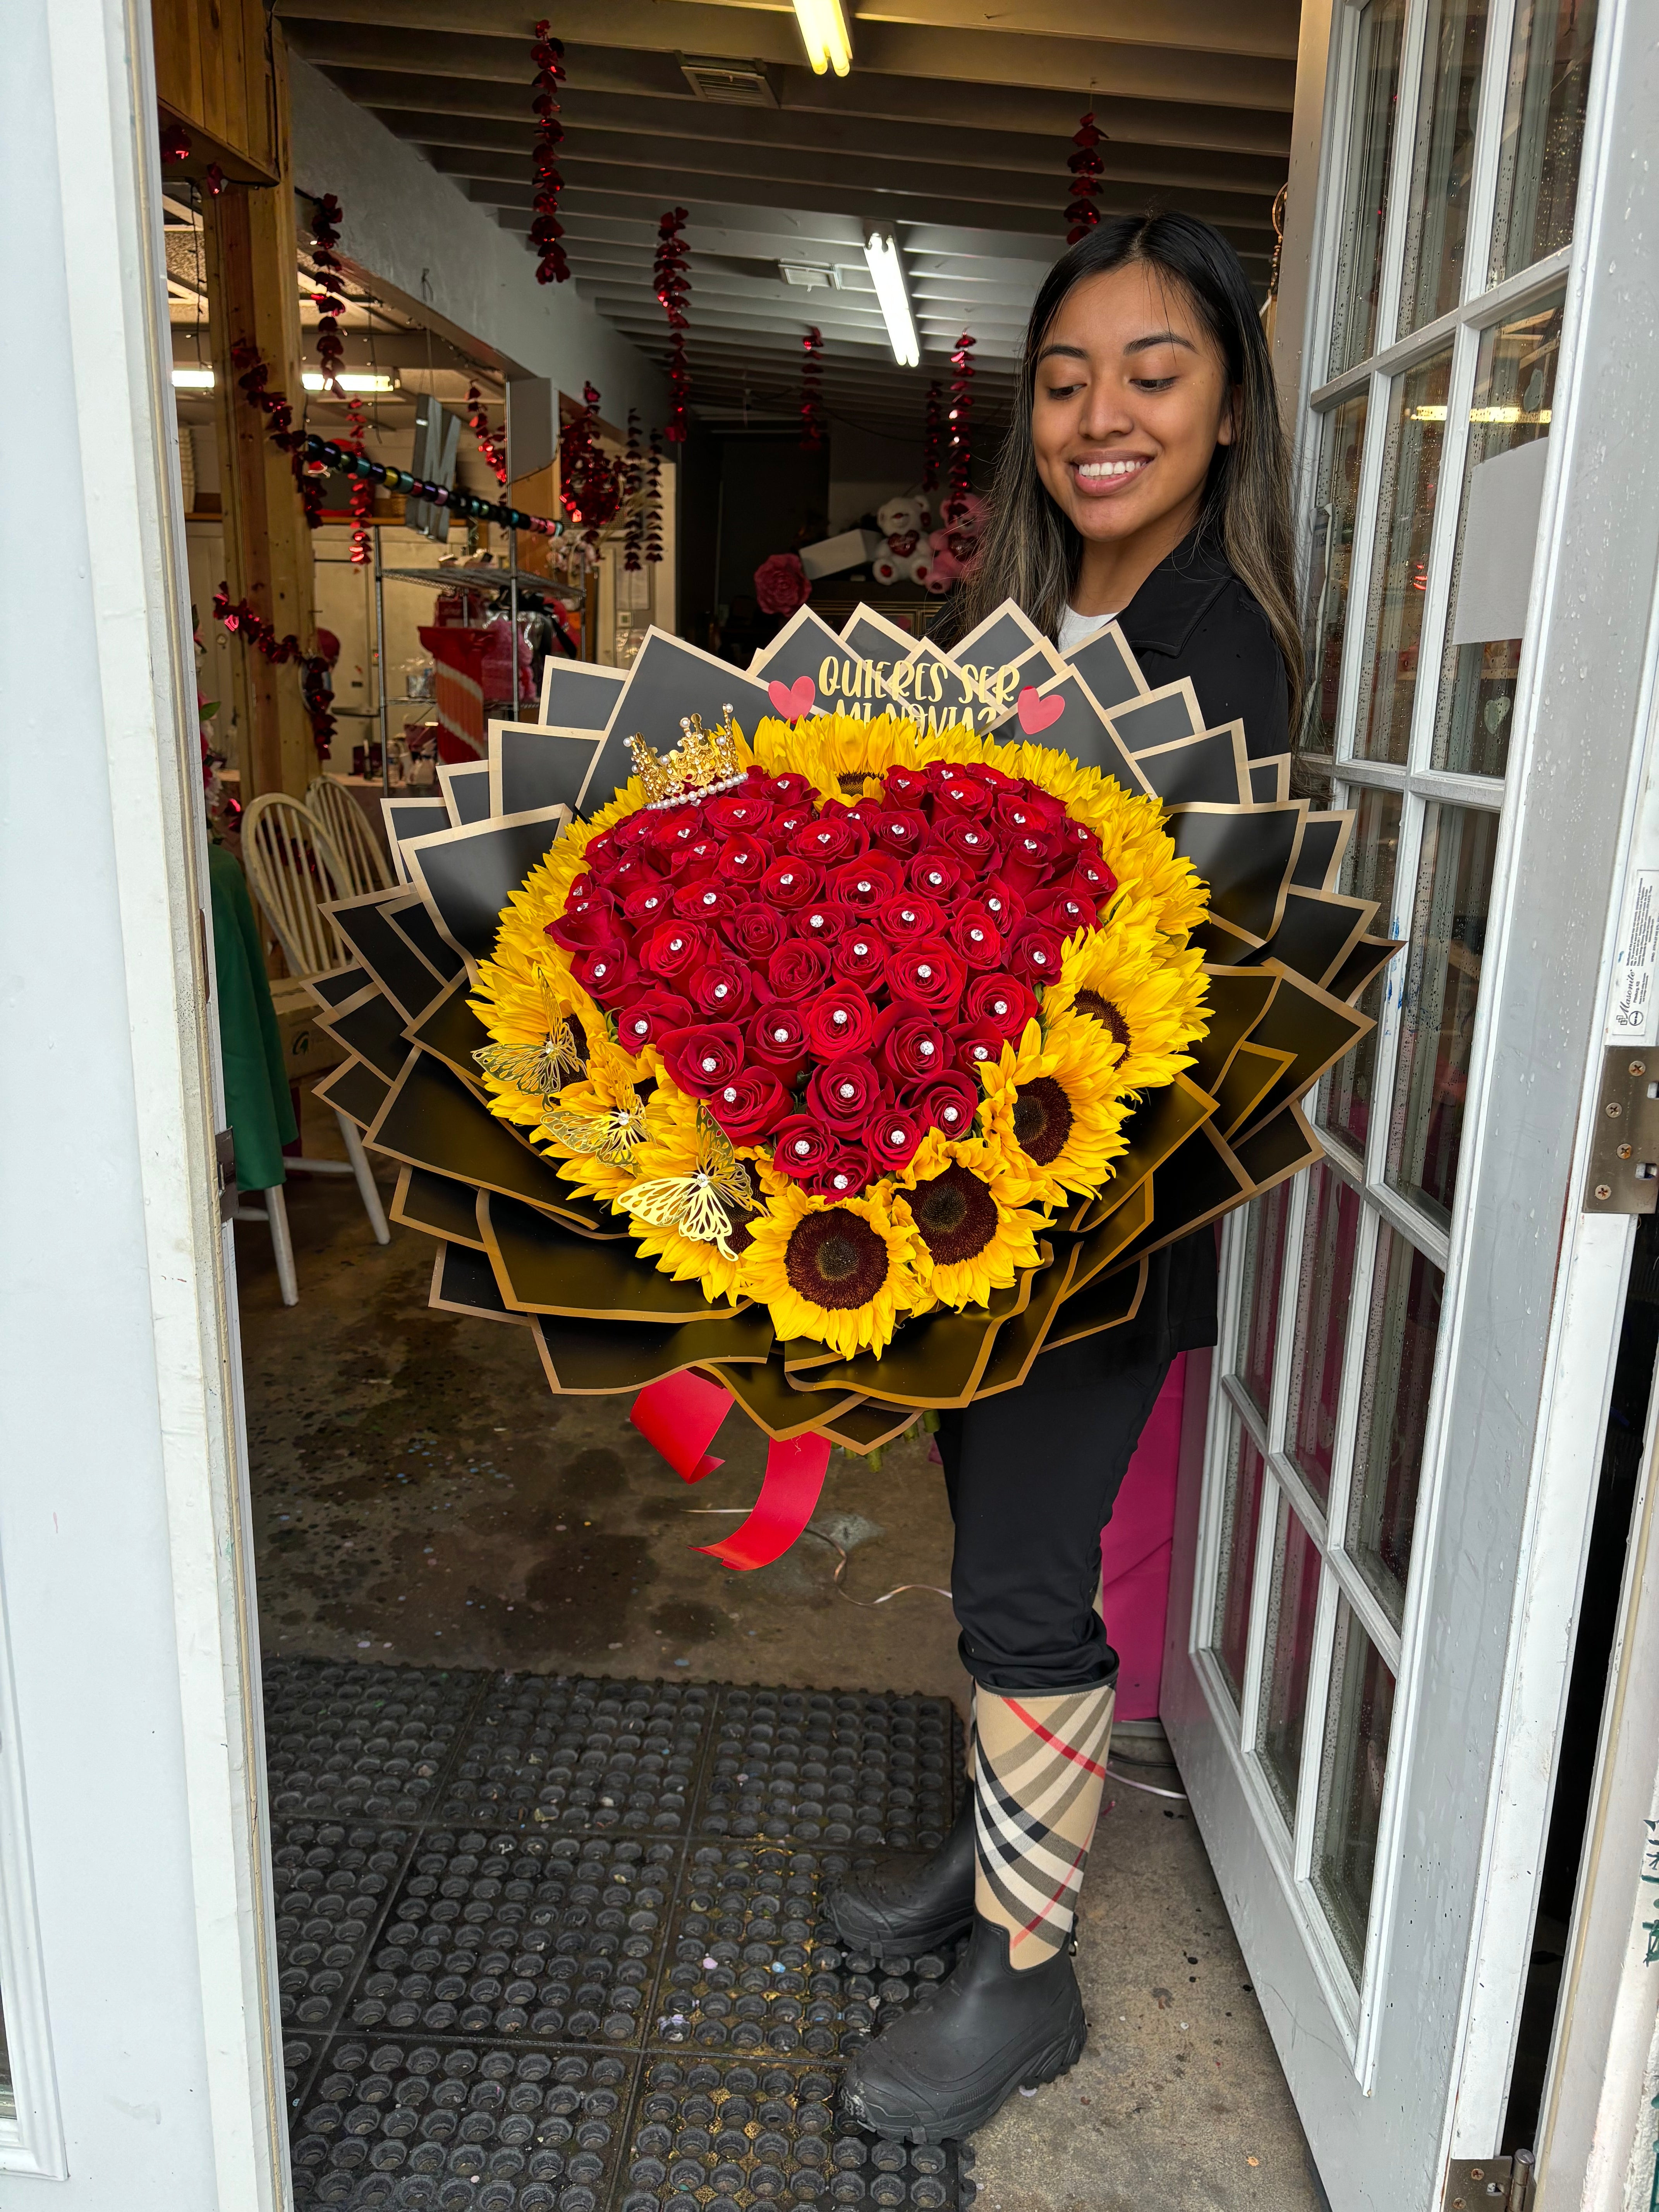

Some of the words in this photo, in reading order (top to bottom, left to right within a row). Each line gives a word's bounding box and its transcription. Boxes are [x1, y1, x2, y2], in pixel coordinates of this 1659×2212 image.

[819, 656, 948, 702] QUIERES
[958, 664, 1020, 706] SER
[1620, 971, 1635, 1019] Masonite
